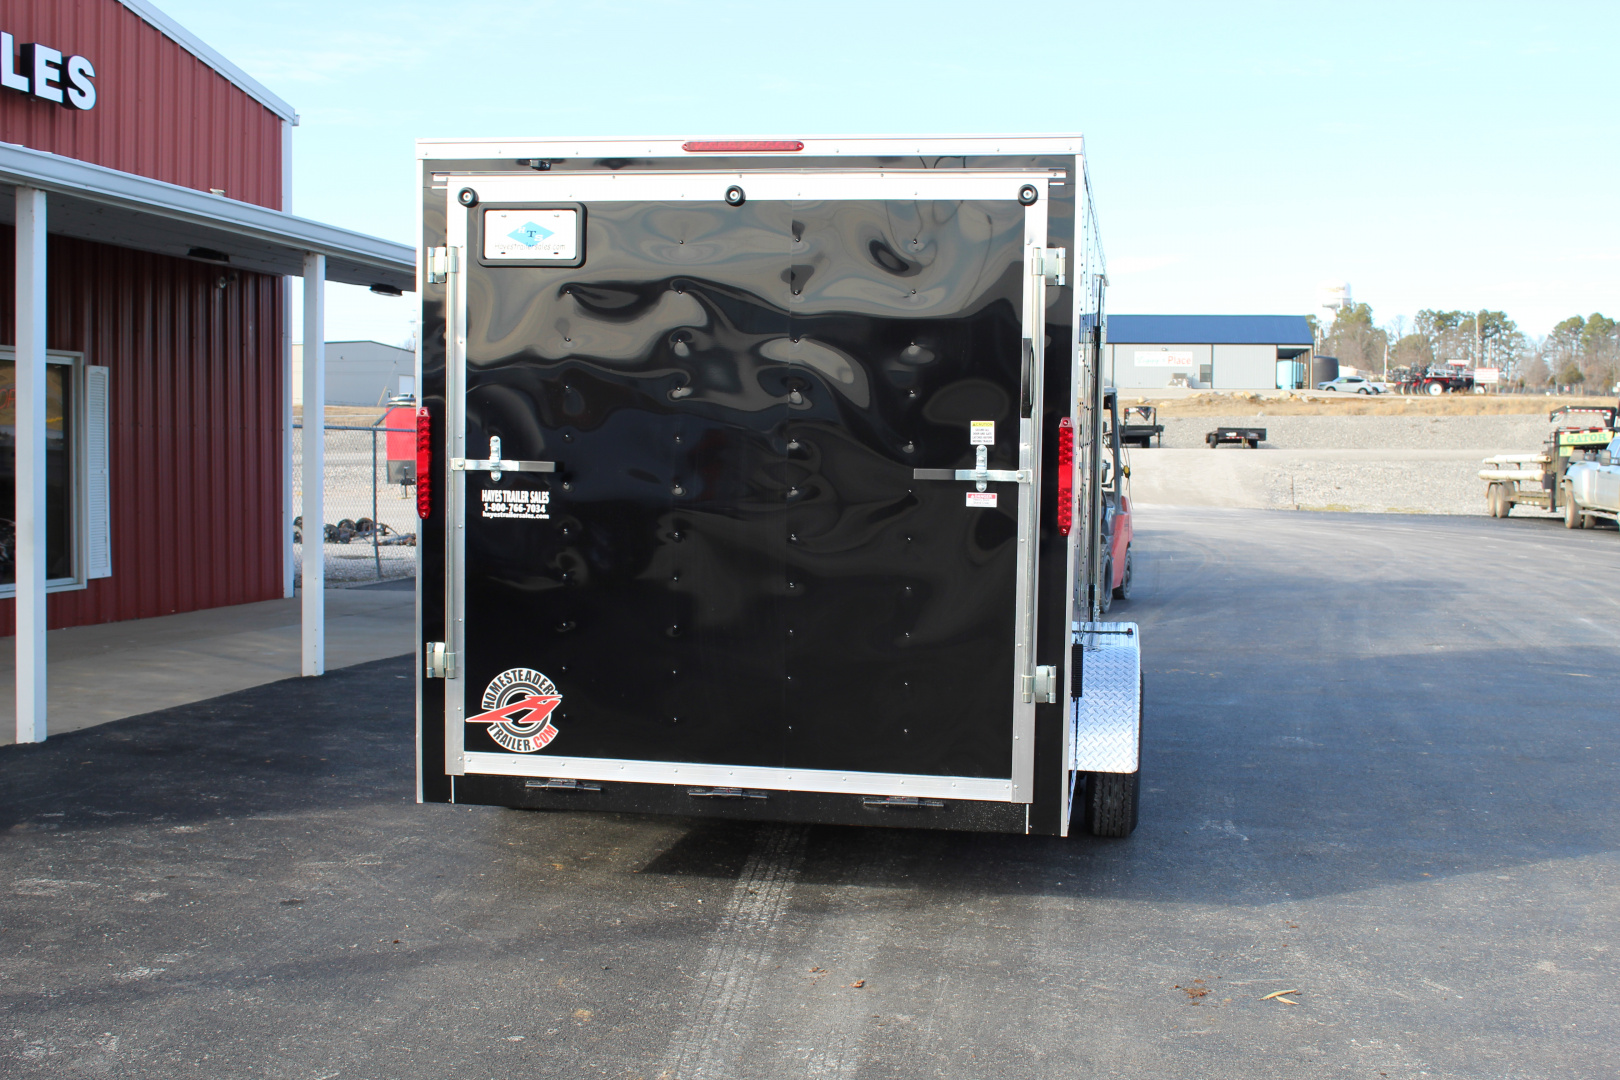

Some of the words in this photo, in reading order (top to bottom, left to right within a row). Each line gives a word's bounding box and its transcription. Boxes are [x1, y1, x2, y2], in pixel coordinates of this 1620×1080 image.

[0, 31, 96, 110] LES
[1167, 356, 1192, 364] Place
[1567, 434, 1607, 443] GATOR
[482, 490, 503, 502] HAYES
[503, 490, 529, 503] TRAILER
[530, 491, 550, 504] SALES
[484, 503, 546, 513] 1-800-766-7034
[483, 670, 554, 709] HOMESTEADER
[488, 723, 557, 751] TRAILER.COM
